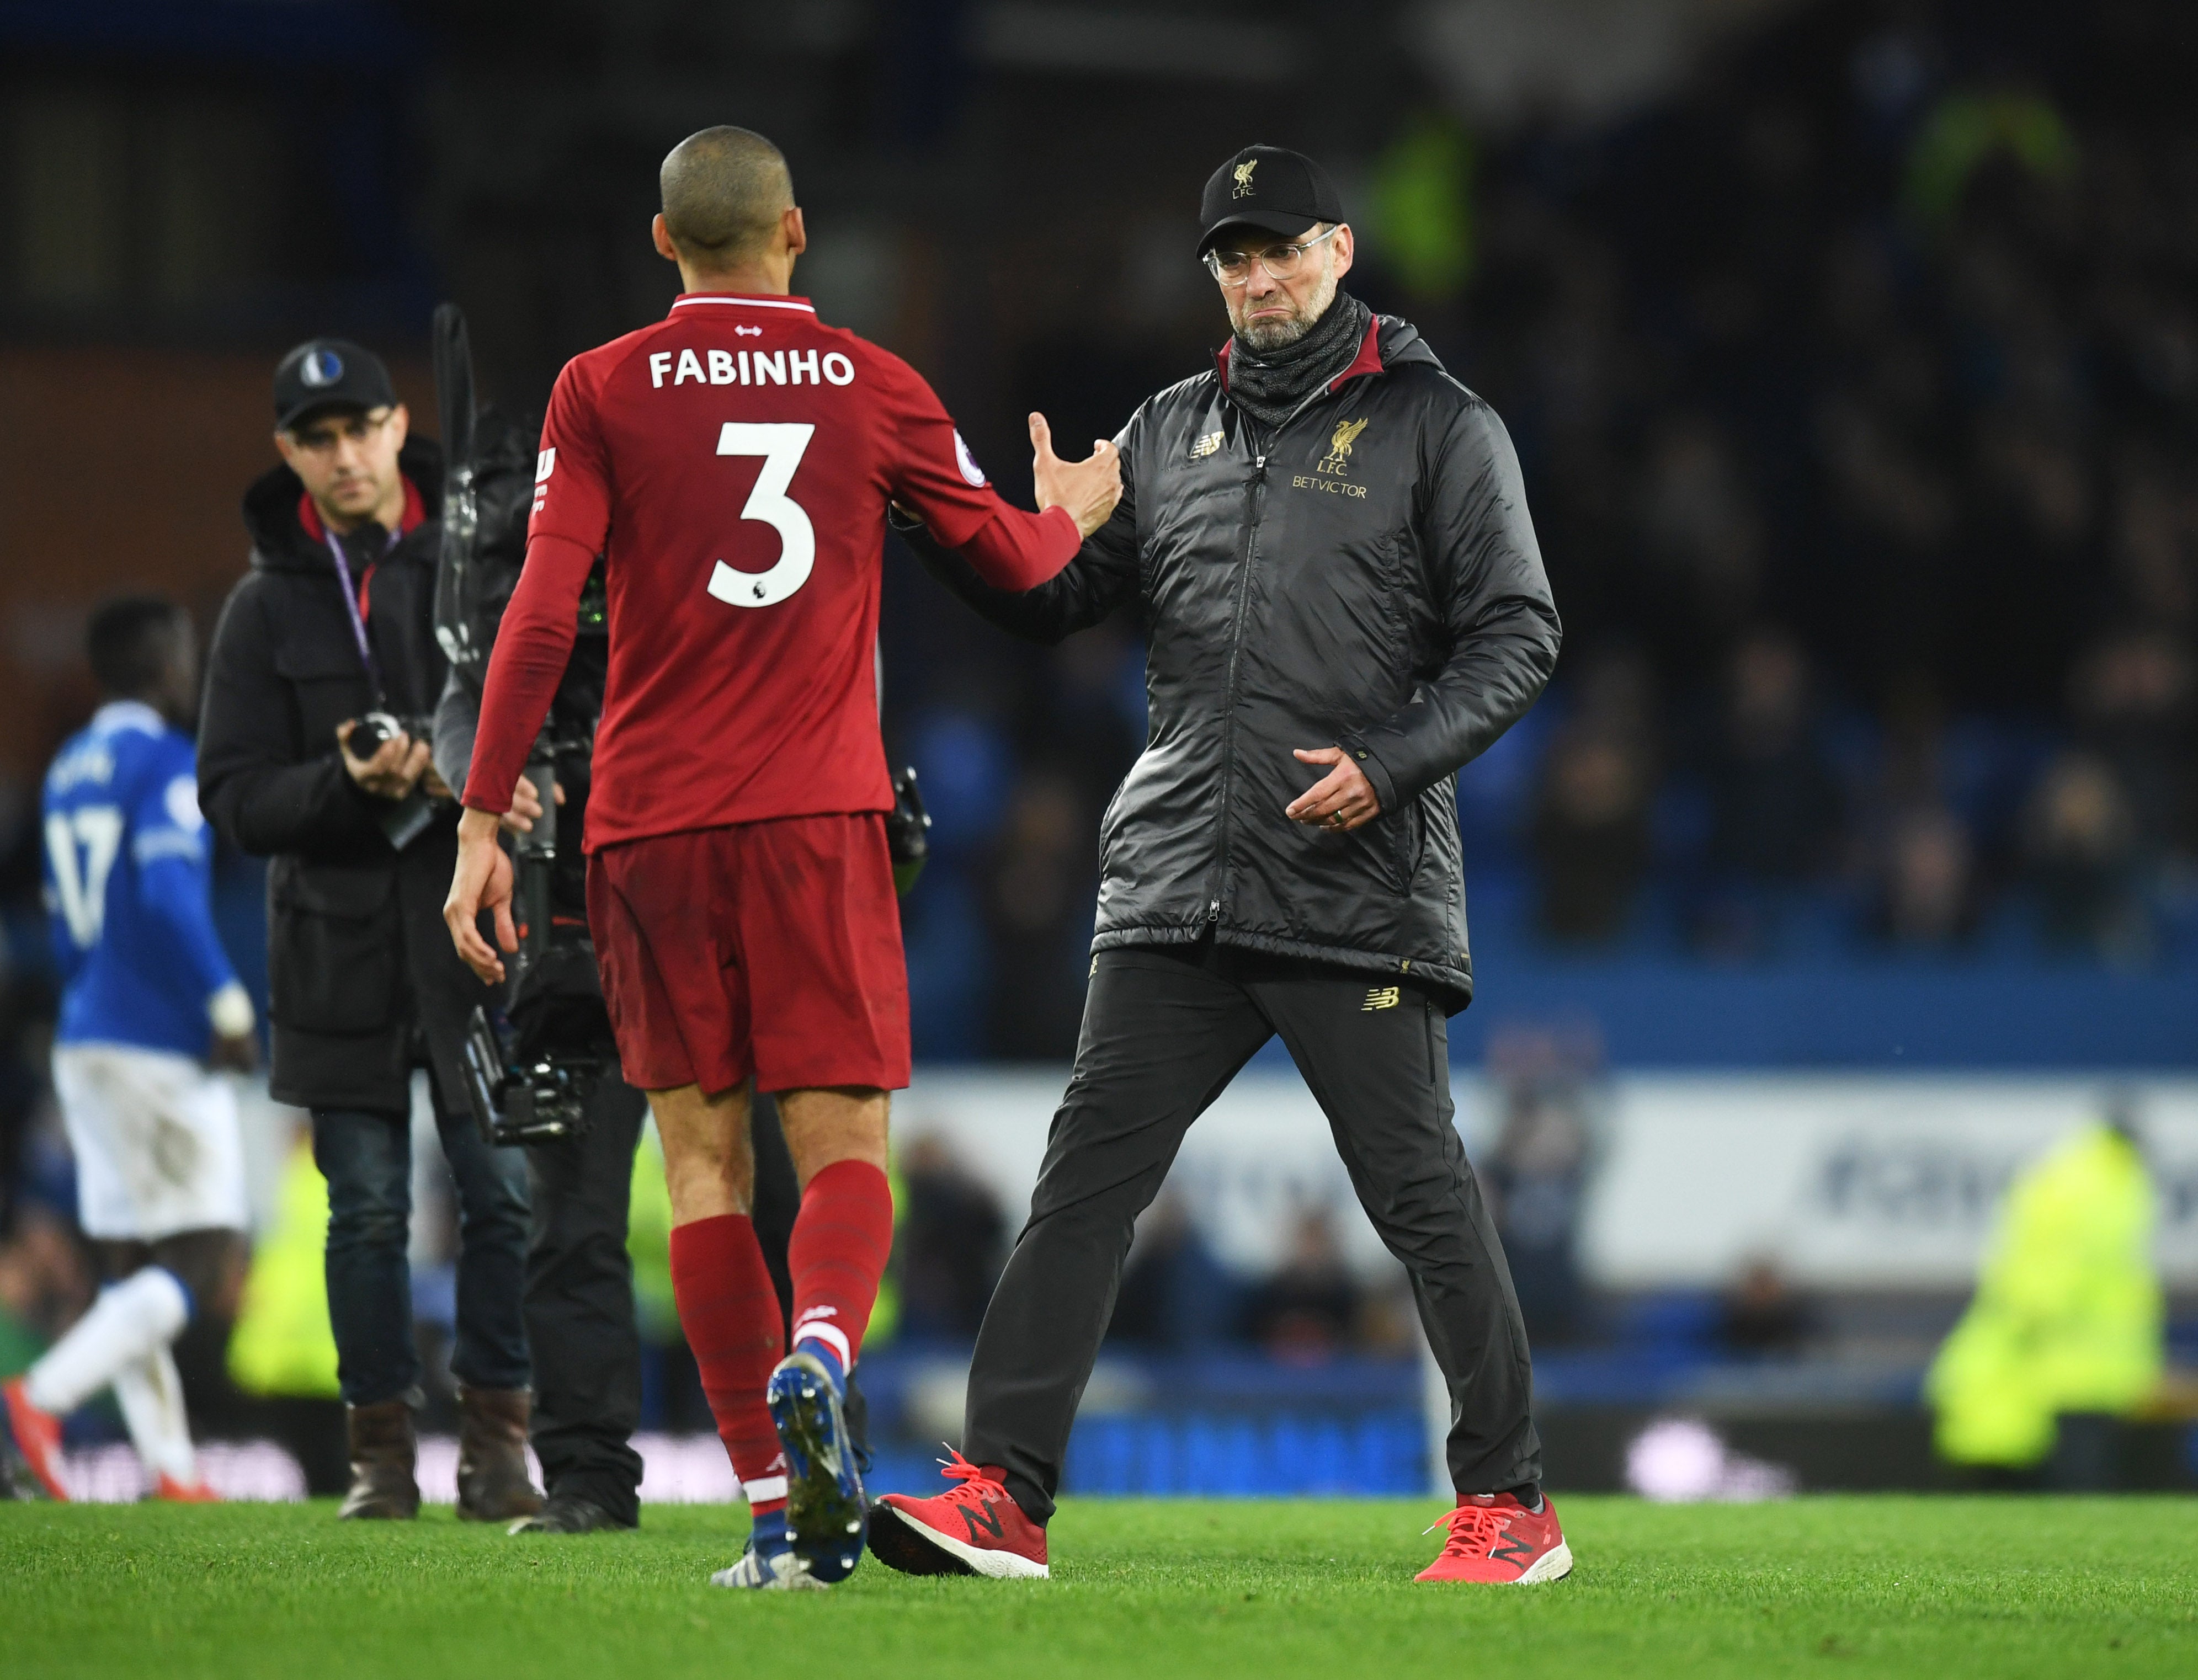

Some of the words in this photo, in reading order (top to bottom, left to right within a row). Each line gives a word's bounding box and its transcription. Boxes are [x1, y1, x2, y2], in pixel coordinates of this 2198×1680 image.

[648, 348, 855, 388] FABINHO
[1292, 475, 1367, 499] BETVICTOR
[706, 422, 816, 608] 3
